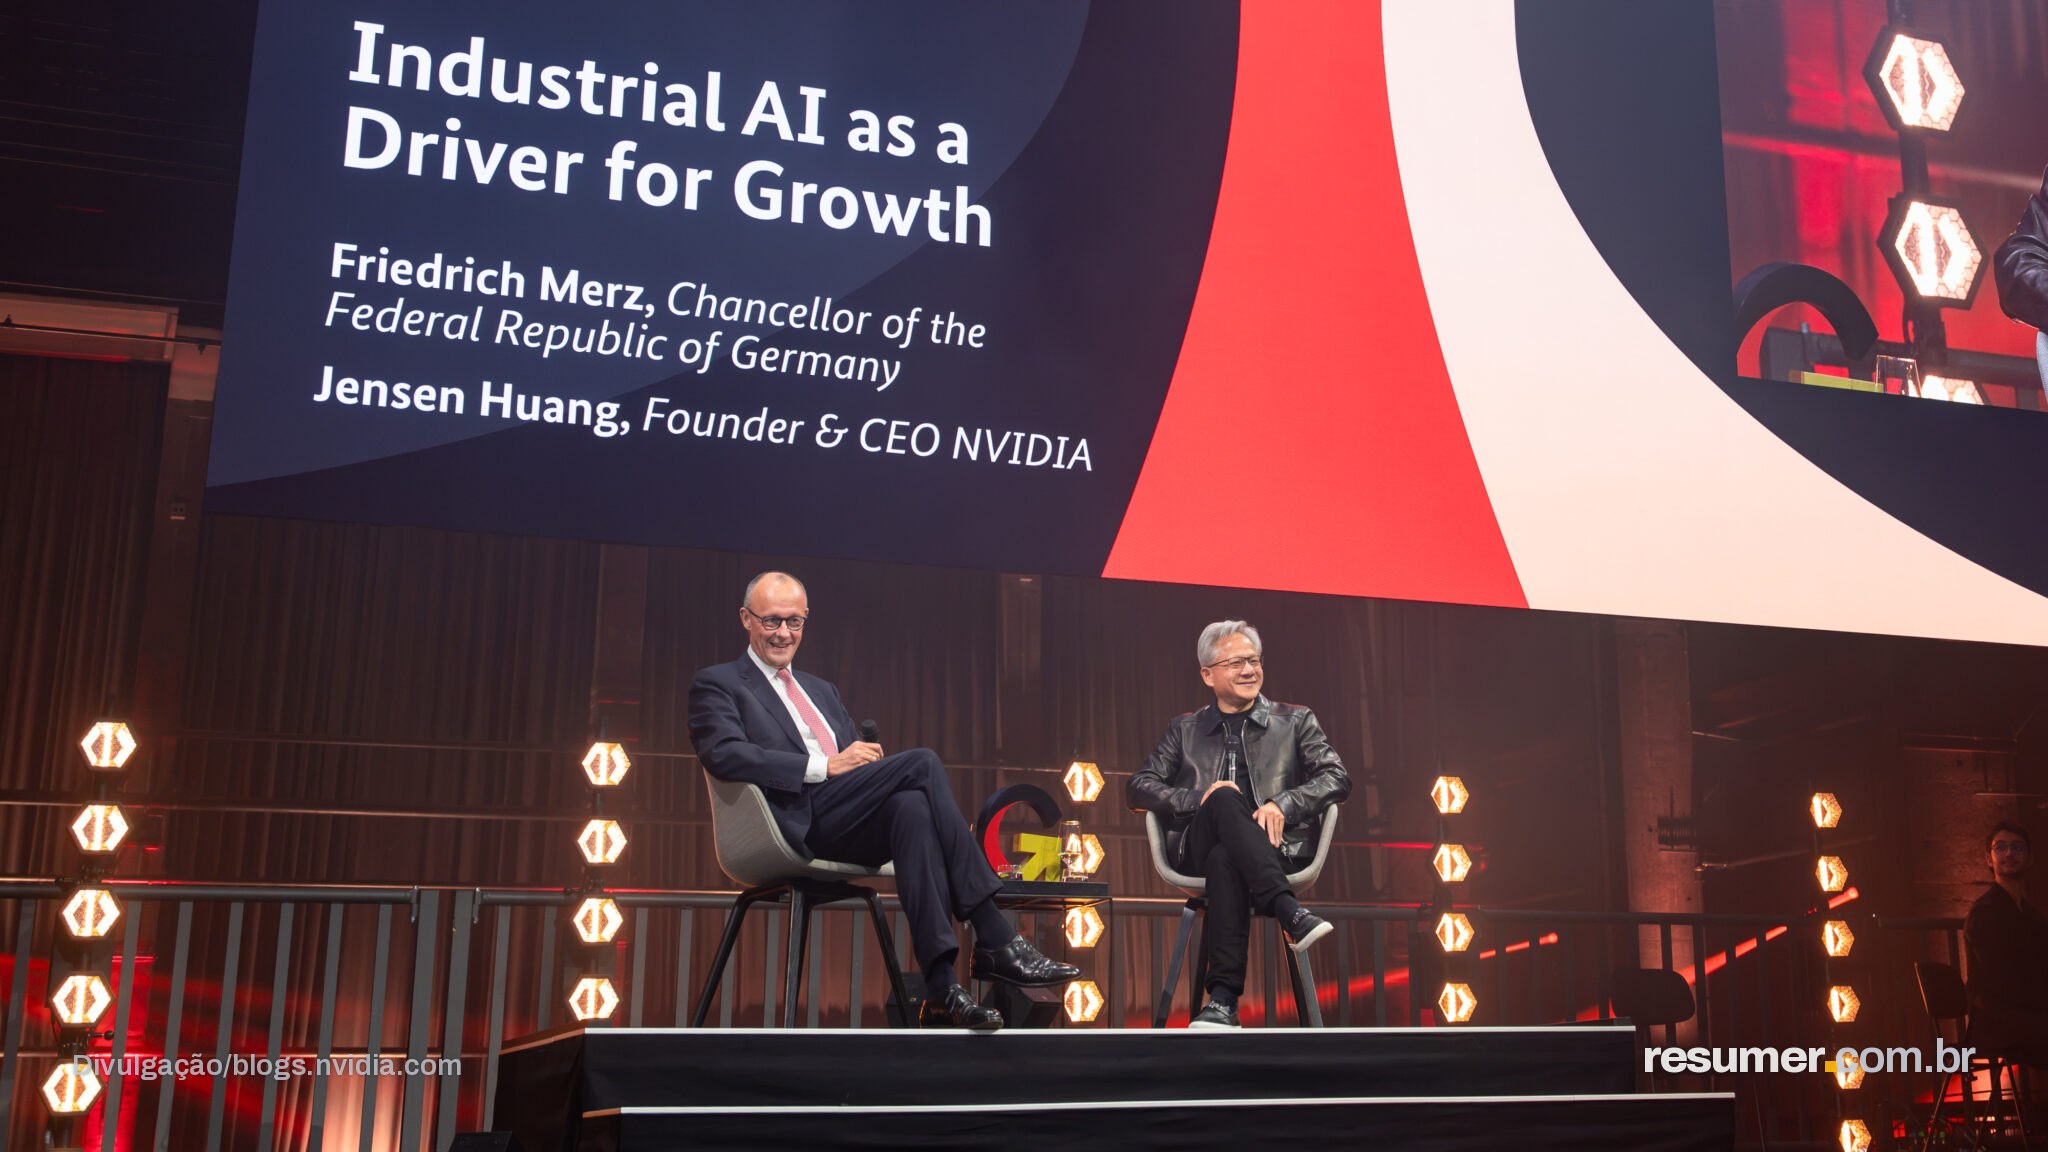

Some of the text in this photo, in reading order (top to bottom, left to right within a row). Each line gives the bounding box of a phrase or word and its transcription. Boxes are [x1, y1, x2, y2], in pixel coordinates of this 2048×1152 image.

[348, 20, 969, 165] Industrial AI as a
[343, 105, 992, 247] Driver for Growth
[324, 291, 901, 392] Federal Republic of Germany
[331, 242, 987, 349] Friedrich Merz, Chancellor of the
[313, 365, 1093, 472] Jensen Huang, Founder & CEO NVIDIA
